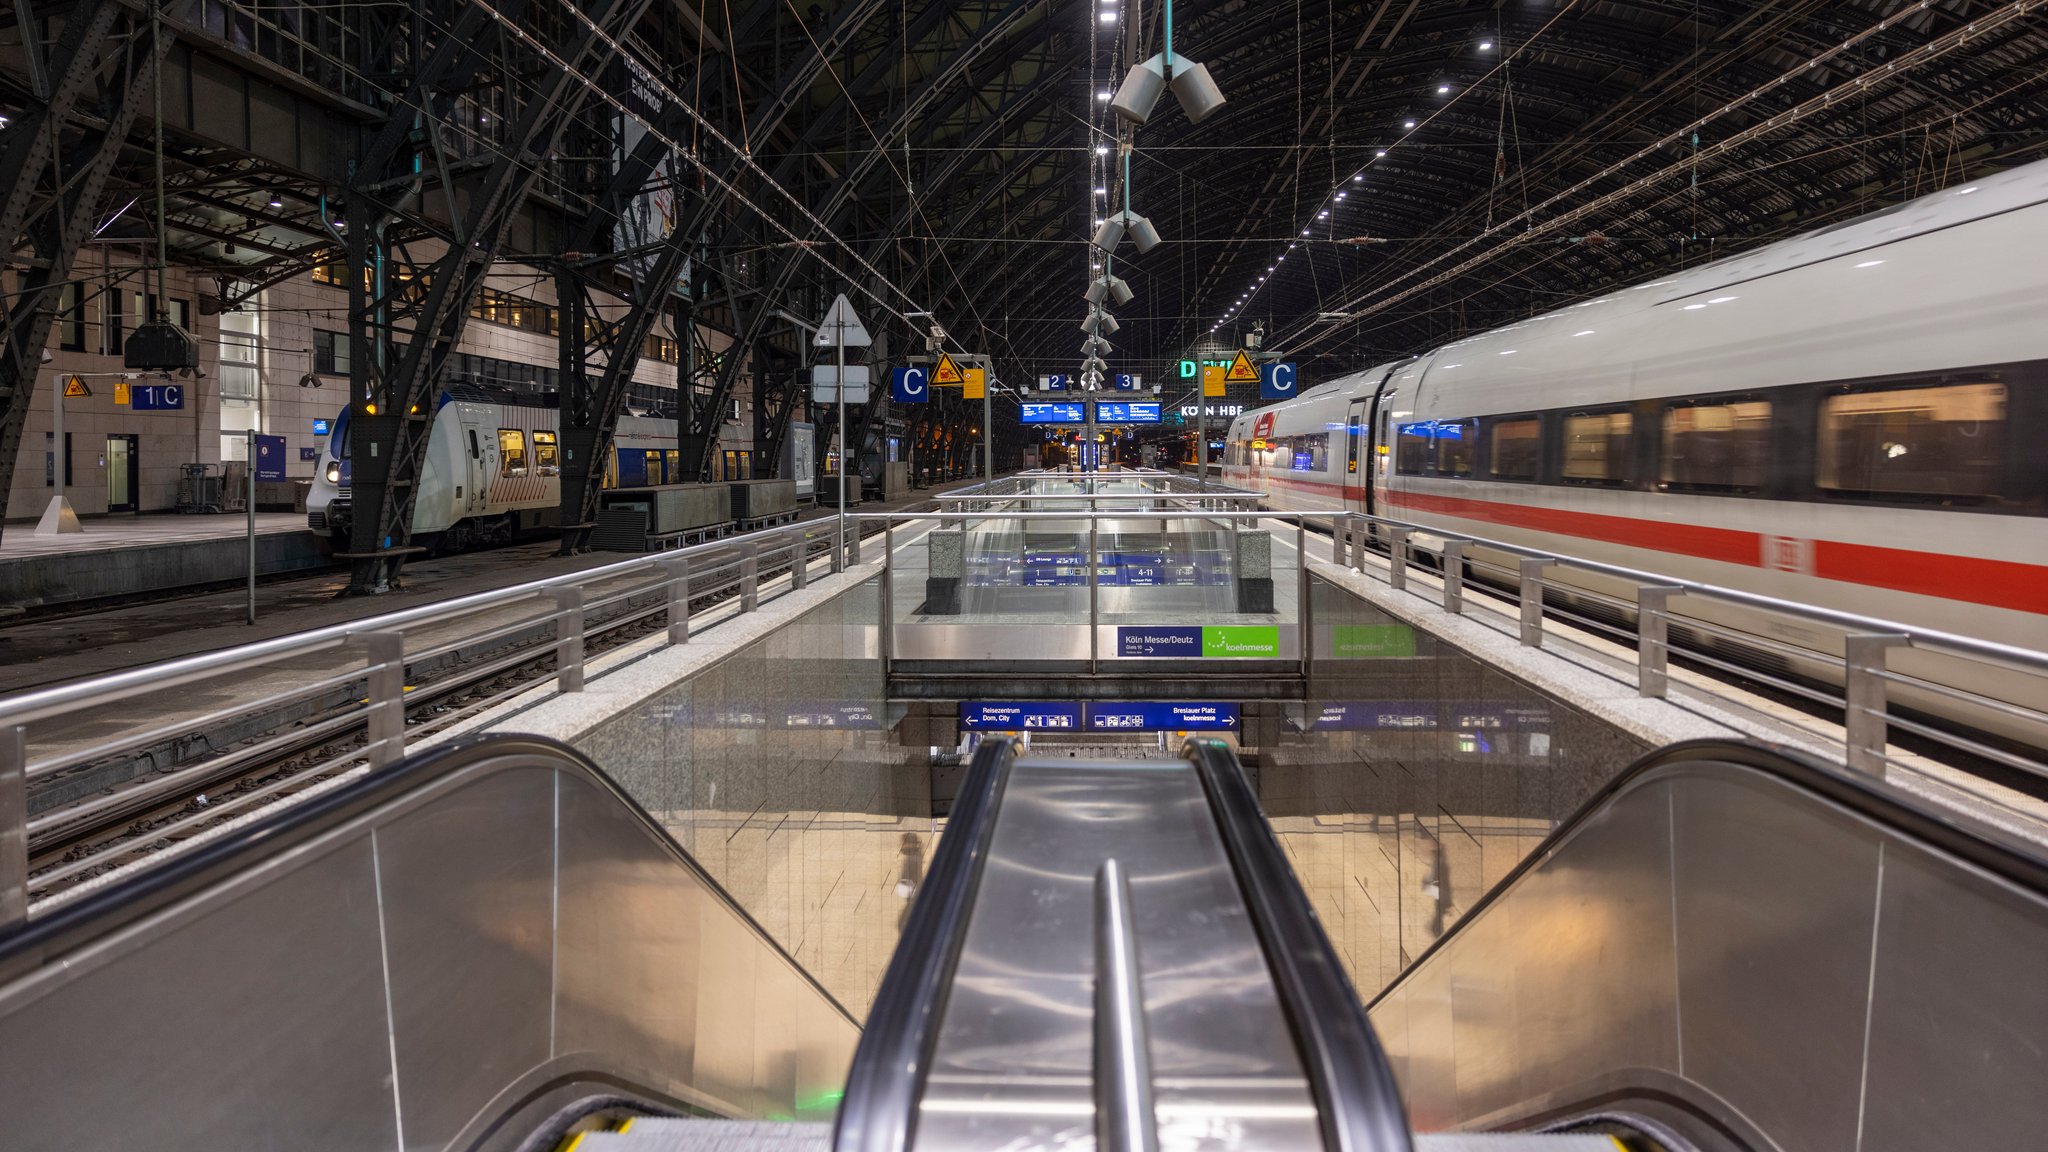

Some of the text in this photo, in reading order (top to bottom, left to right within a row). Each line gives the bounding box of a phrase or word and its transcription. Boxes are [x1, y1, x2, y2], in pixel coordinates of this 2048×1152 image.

[903, 368, 923, 395] C
[1051, 375, 1059, 388] 2
[1122, 374, 1130, 388] 3
[1271, 364, 1292, 391] C
[145, 386, 153, 405] 1
[164, 386, 178, 405] C
[1181, 405, 1243, 416] KÖN HBF
[1144, 636, 1194, 644] Messe/Deutz
[1226, 643, 1273, 652] koelnmesse
